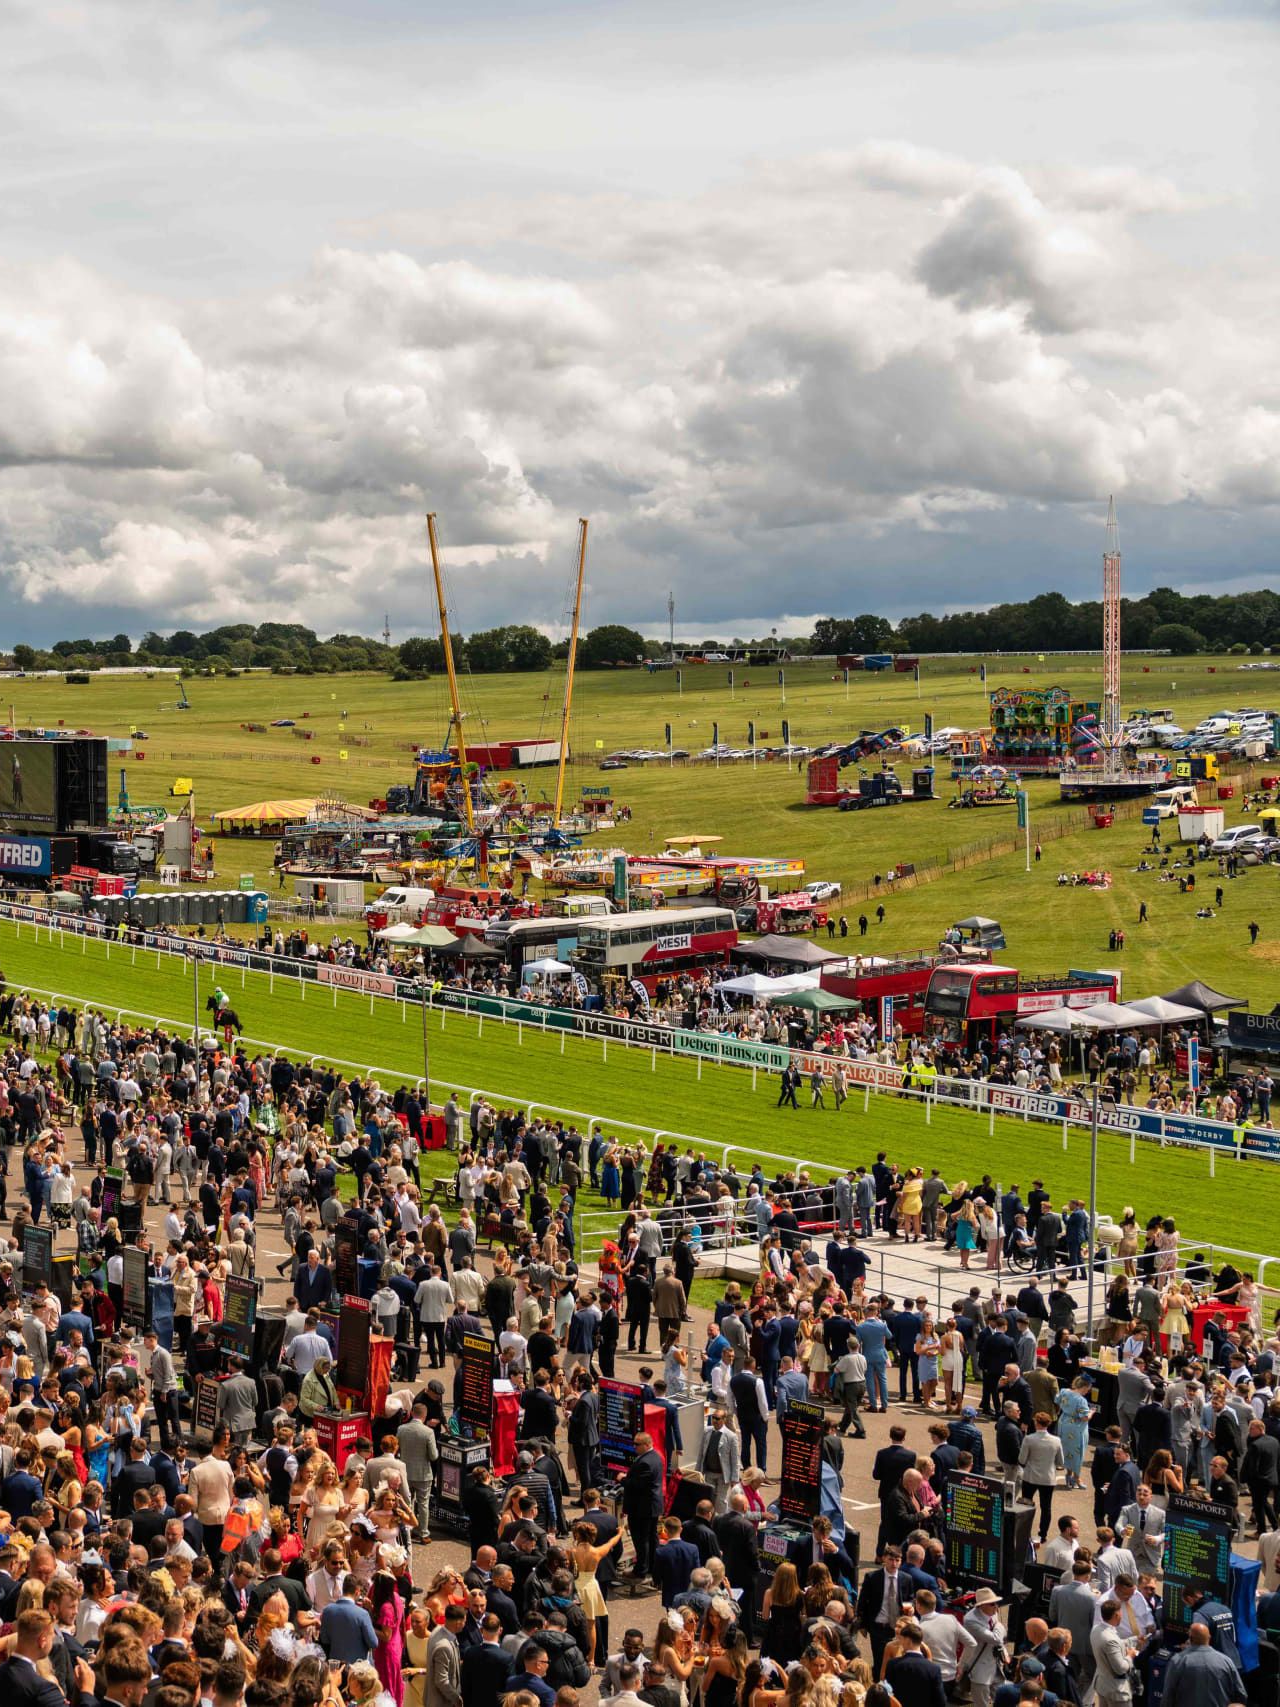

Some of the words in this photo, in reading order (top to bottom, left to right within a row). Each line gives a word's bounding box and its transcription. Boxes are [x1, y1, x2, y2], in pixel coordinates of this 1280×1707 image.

[658, 936, 689, 949] MESH
[1197, 1130, 1224, 1141] DERBY
[342, 1424, 356, 1432] Dave
[340, 1431, 358, 1440] Hazell
[766, 1535, 785, 1547] CASH
[766, 1543, 785, 1555] ONLY
